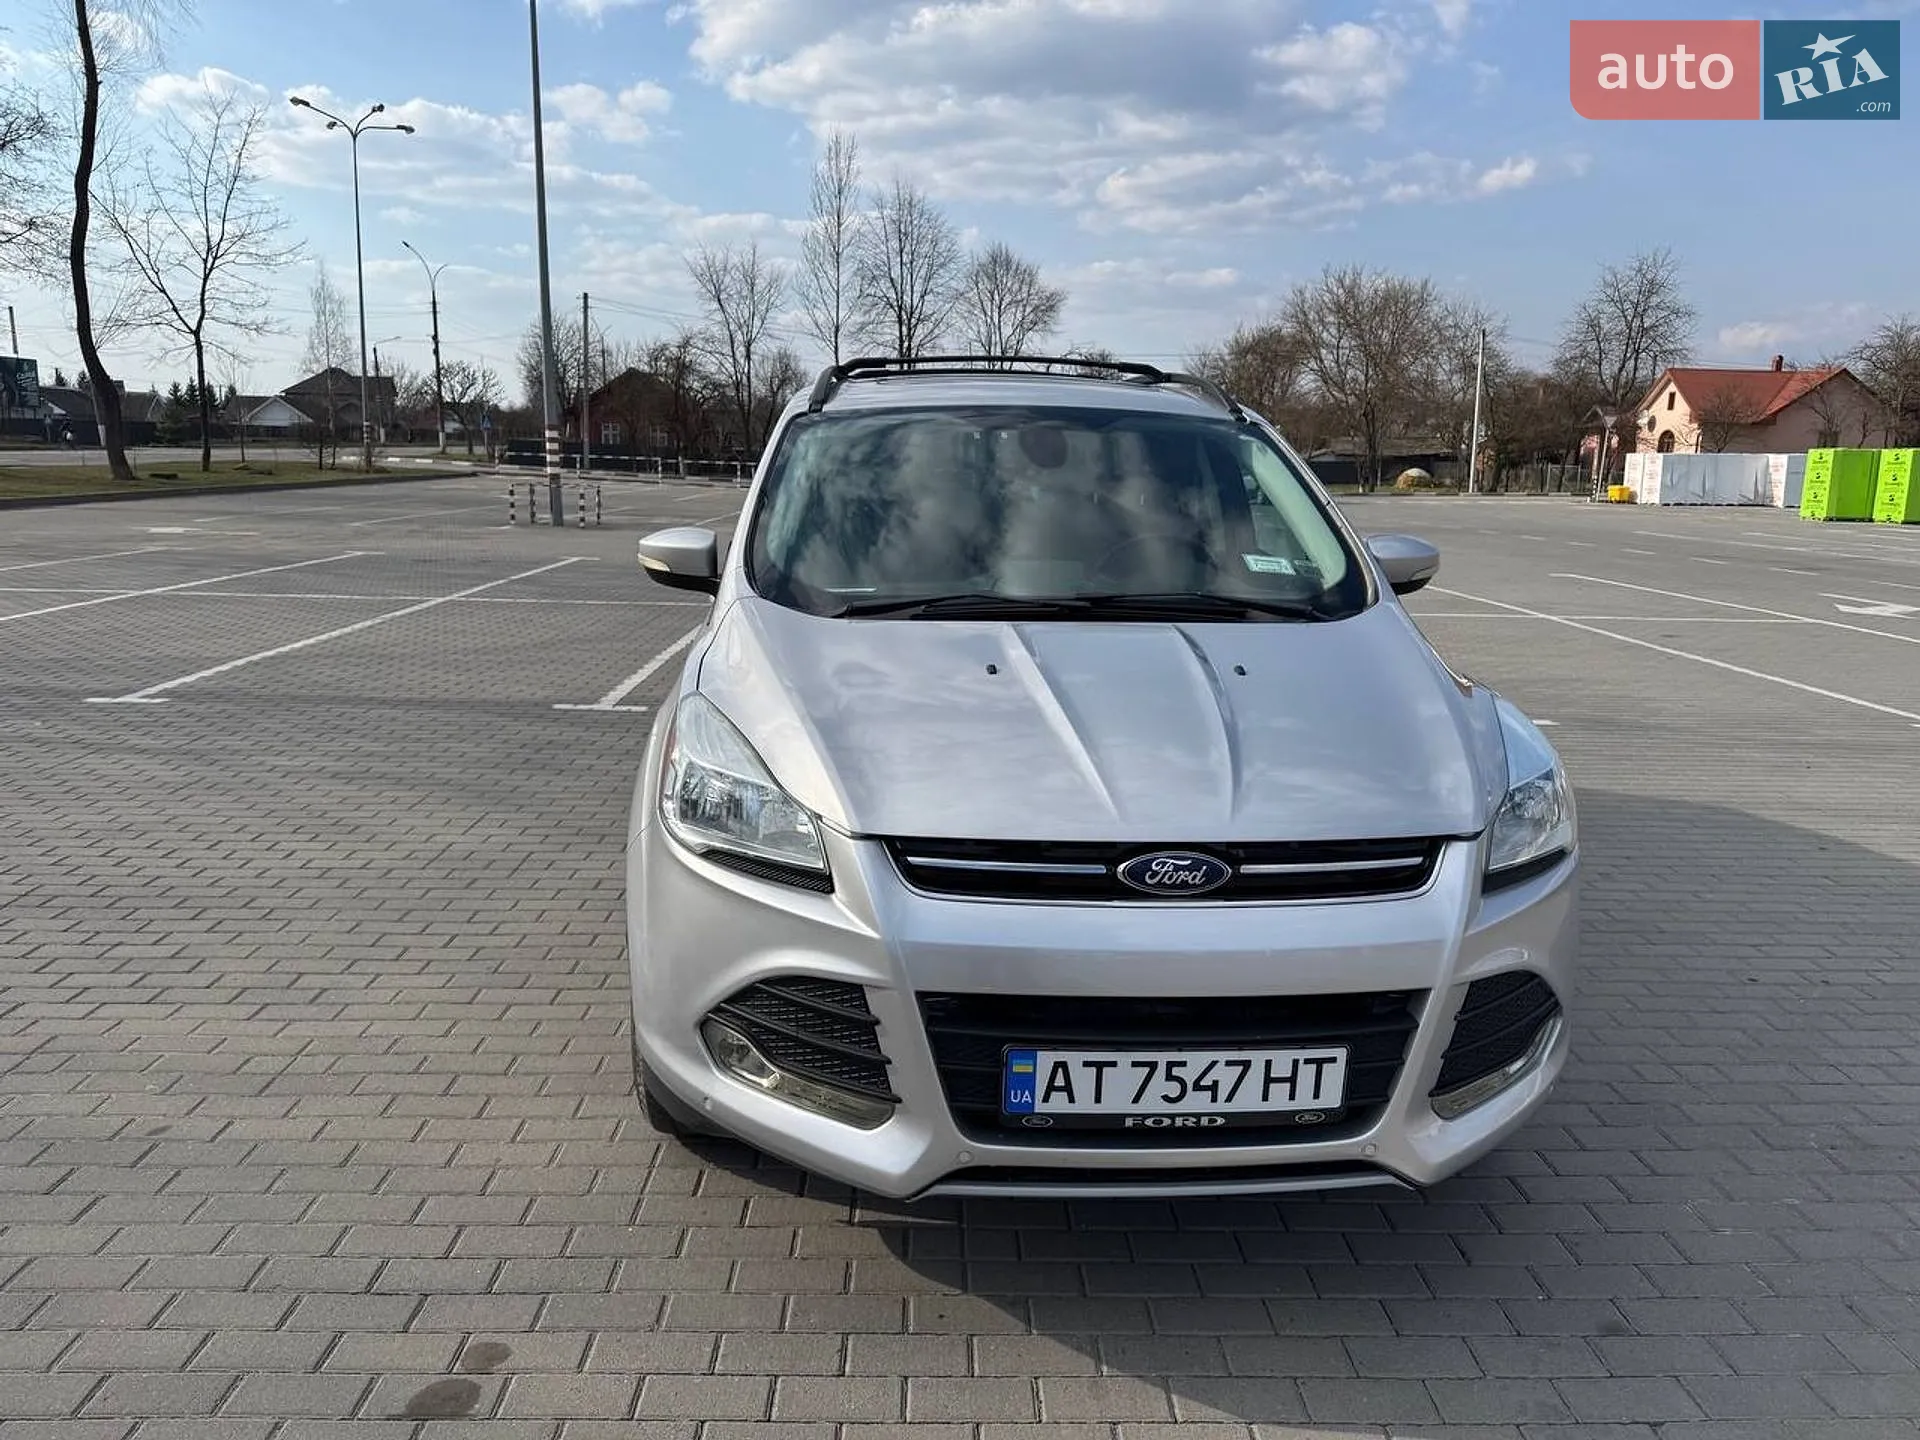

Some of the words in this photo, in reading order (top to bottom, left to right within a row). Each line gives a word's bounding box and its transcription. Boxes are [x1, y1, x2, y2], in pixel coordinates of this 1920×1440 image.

[1145, 858, 1208, 885] Ford
[1041, 1060, 1118, 1104] AT
[1130, 1059, 1253, 1104] 7547
[1010, 1089, 1032, 1104] UA
[1124, 1115, 1226, 1128] FORD
